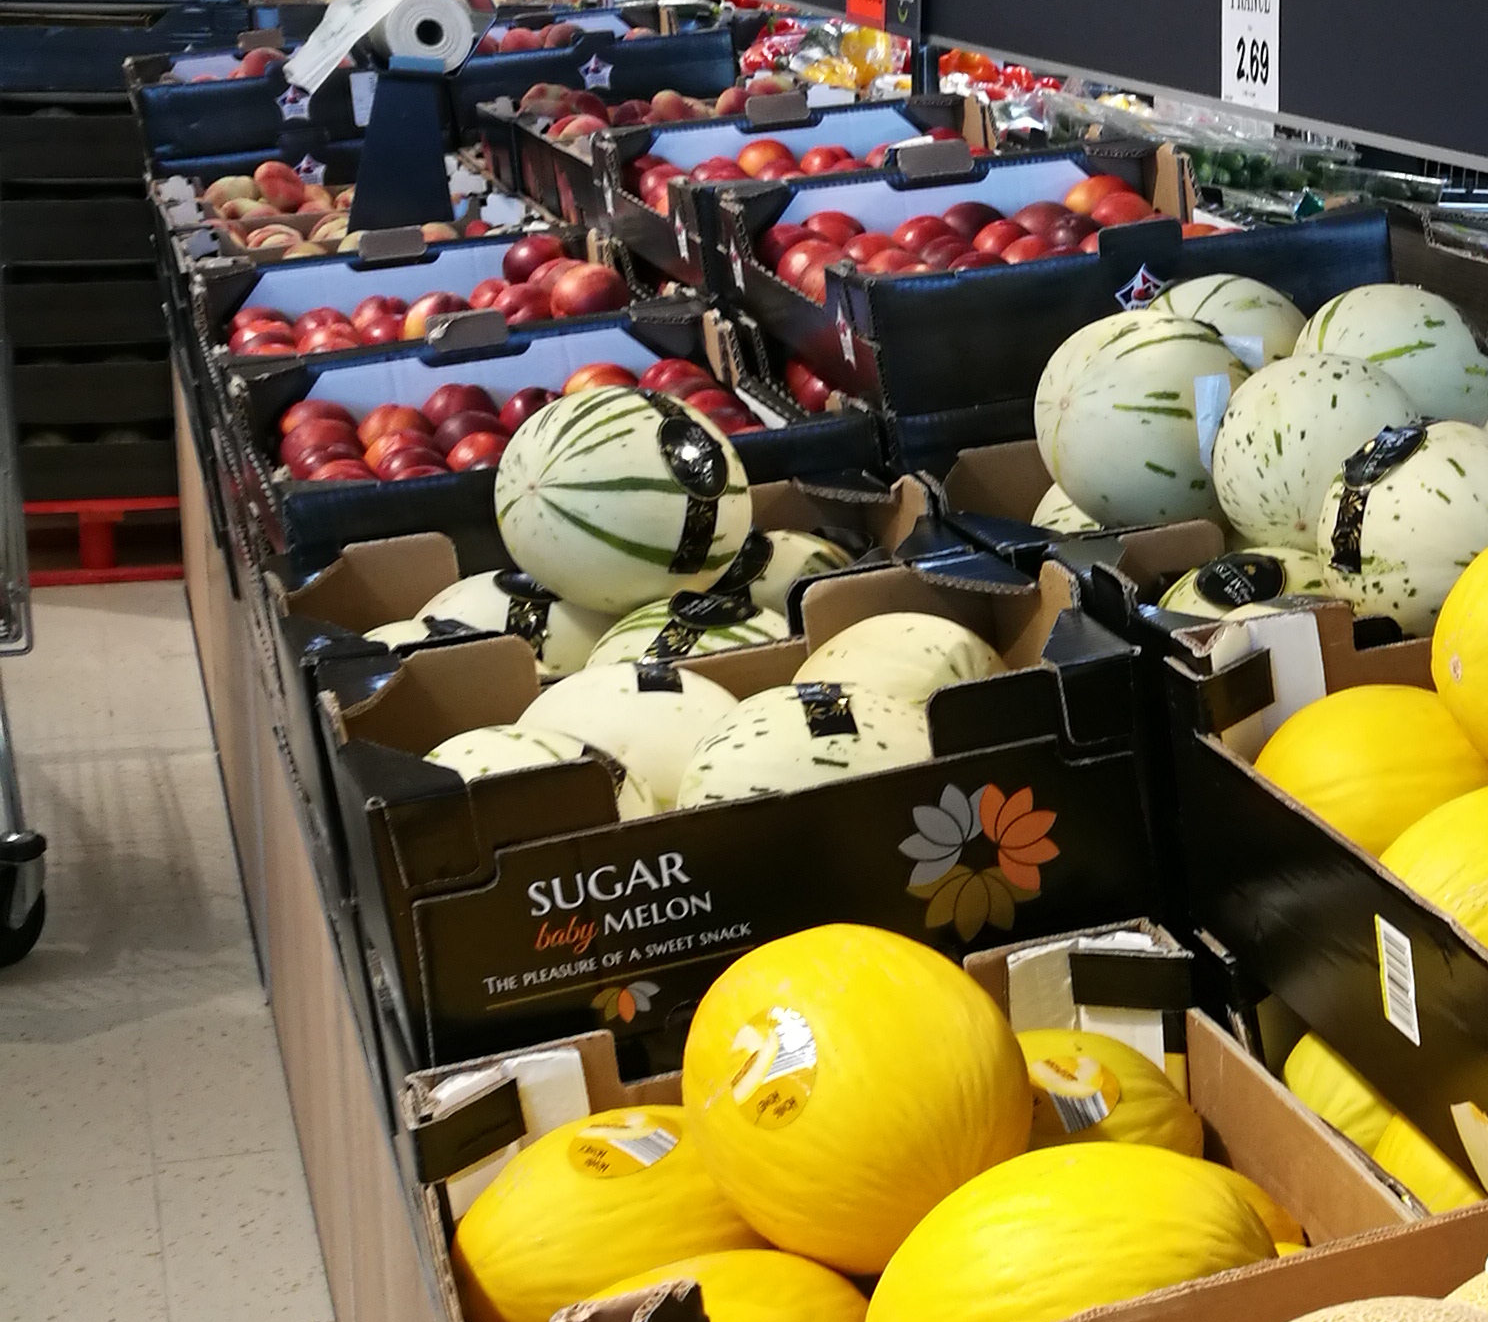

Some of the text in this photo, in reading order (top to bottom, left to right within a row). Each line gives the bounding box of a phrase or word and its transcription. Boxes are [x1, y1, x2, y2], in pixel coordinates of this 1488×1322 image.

[1236, 36, 1269, 86] 2.69
[527, 851, 692, 917] SUGAR
[522, 956, 599, 987] PLEASURE
[602, 950, 624, 968] OF
[628, 946, 642, 962] A
[645, 934, 696, 959] SWEET
[699, 922, 752, 946] SNACK
[534, 890, 713, 955] baby MELON
